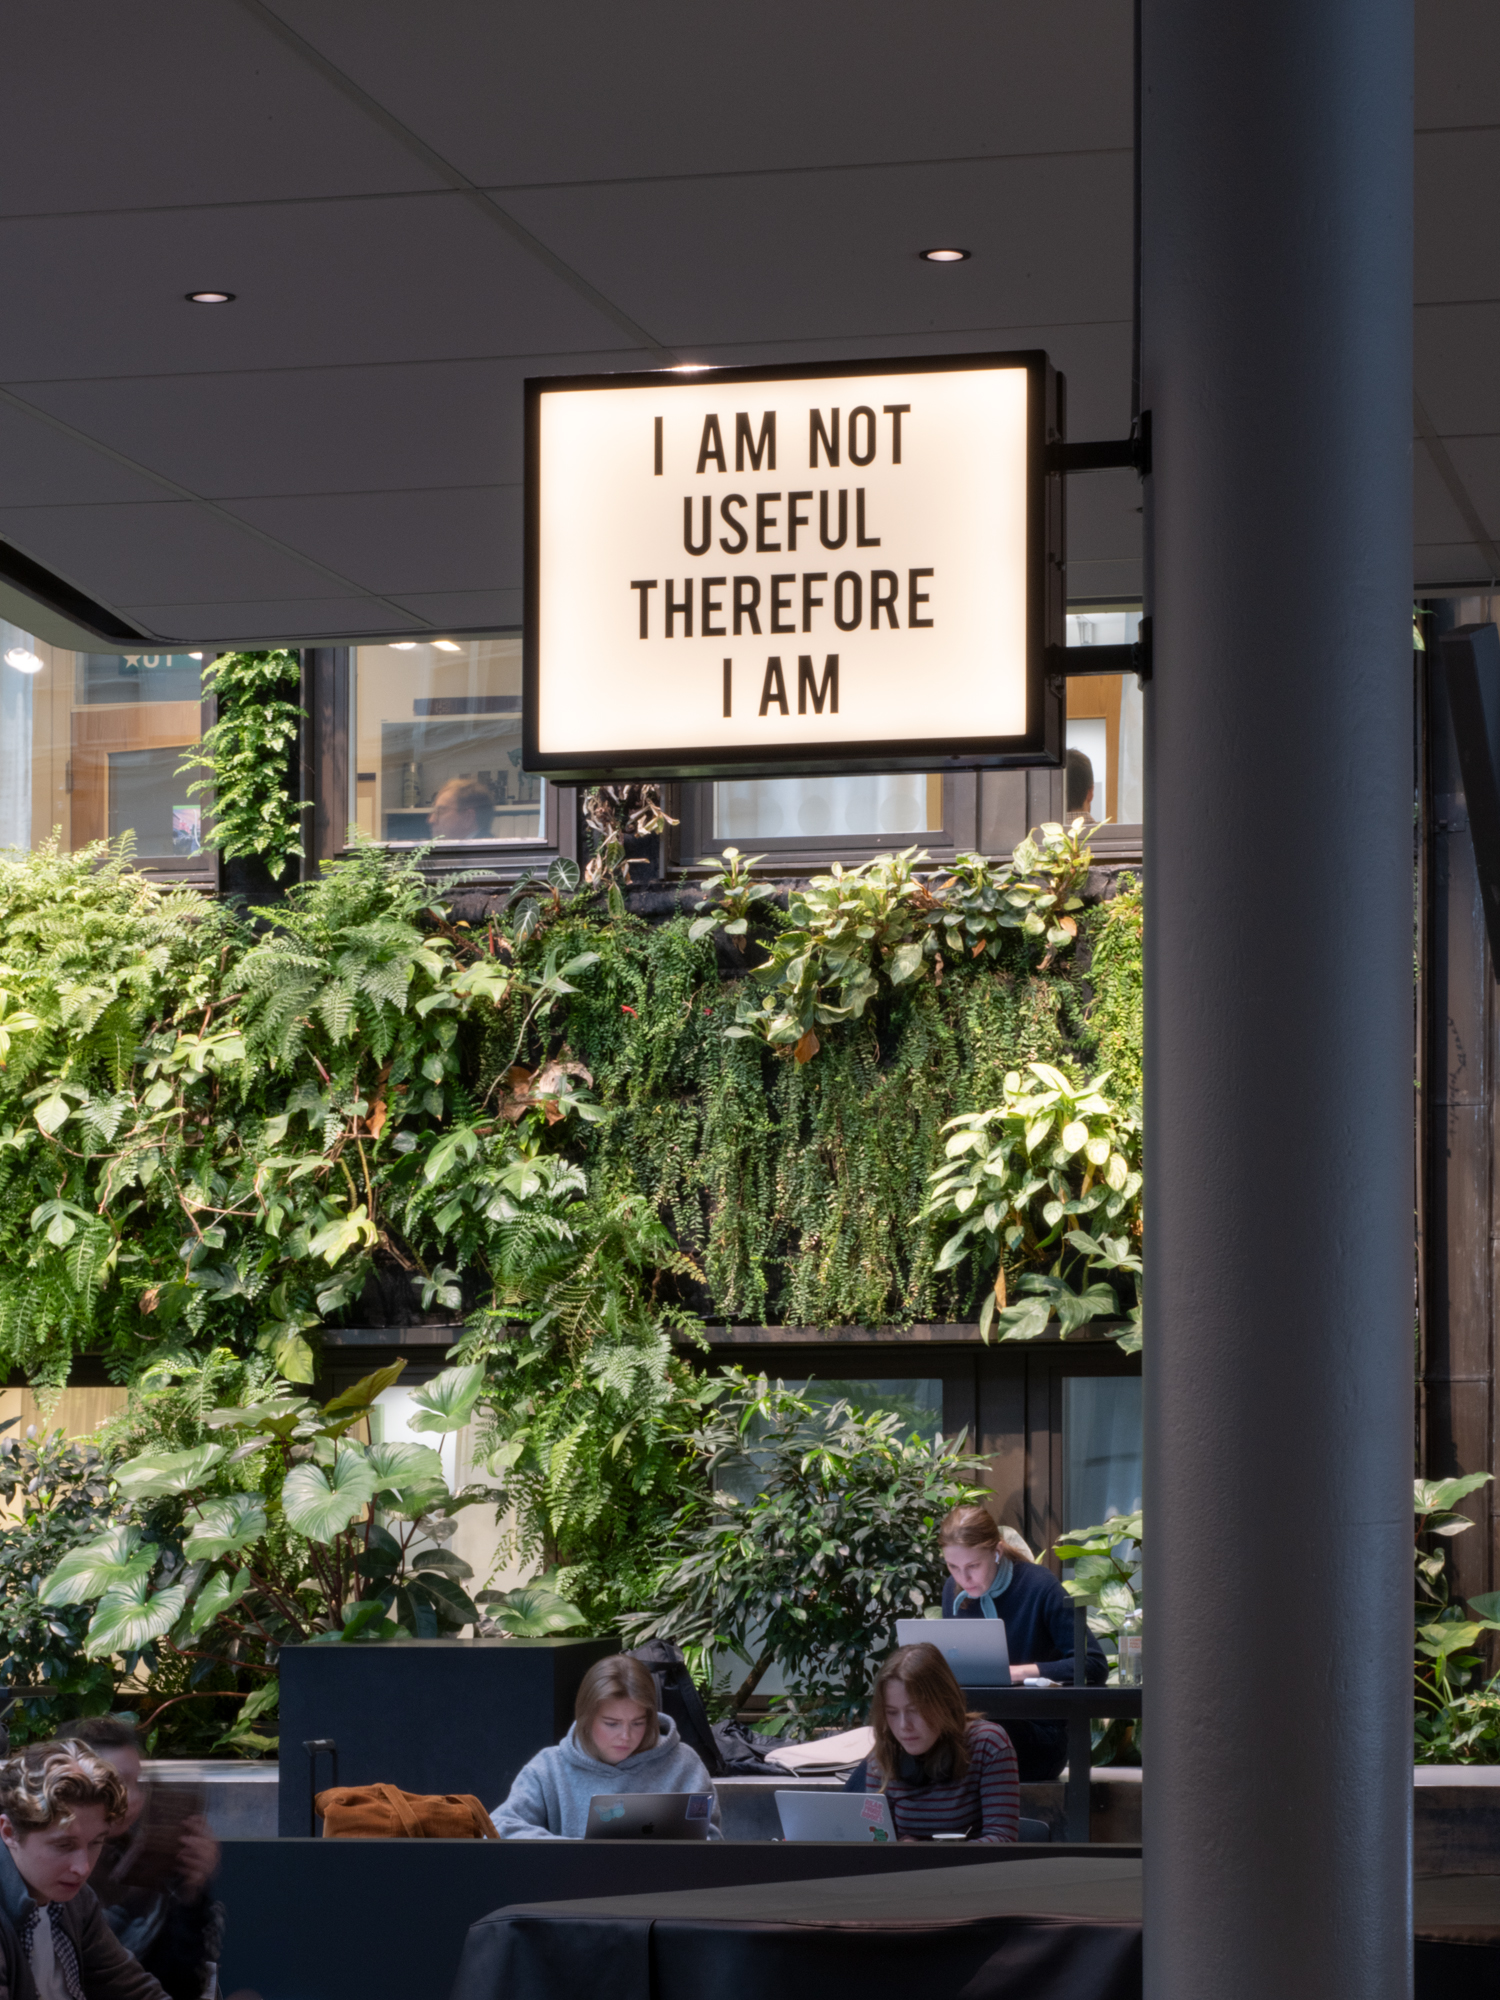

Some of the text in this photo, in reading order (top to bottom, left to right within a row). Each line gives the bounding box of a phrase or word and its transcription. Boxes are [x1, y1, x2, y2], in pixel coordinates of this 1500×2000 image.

[654, 404, 911, 476] I AM NOT
[683, 487, 881, 557] USEFUL
[630, 567, 934, 640] THEREFORE
[723, 653, 840, 718] I AM
